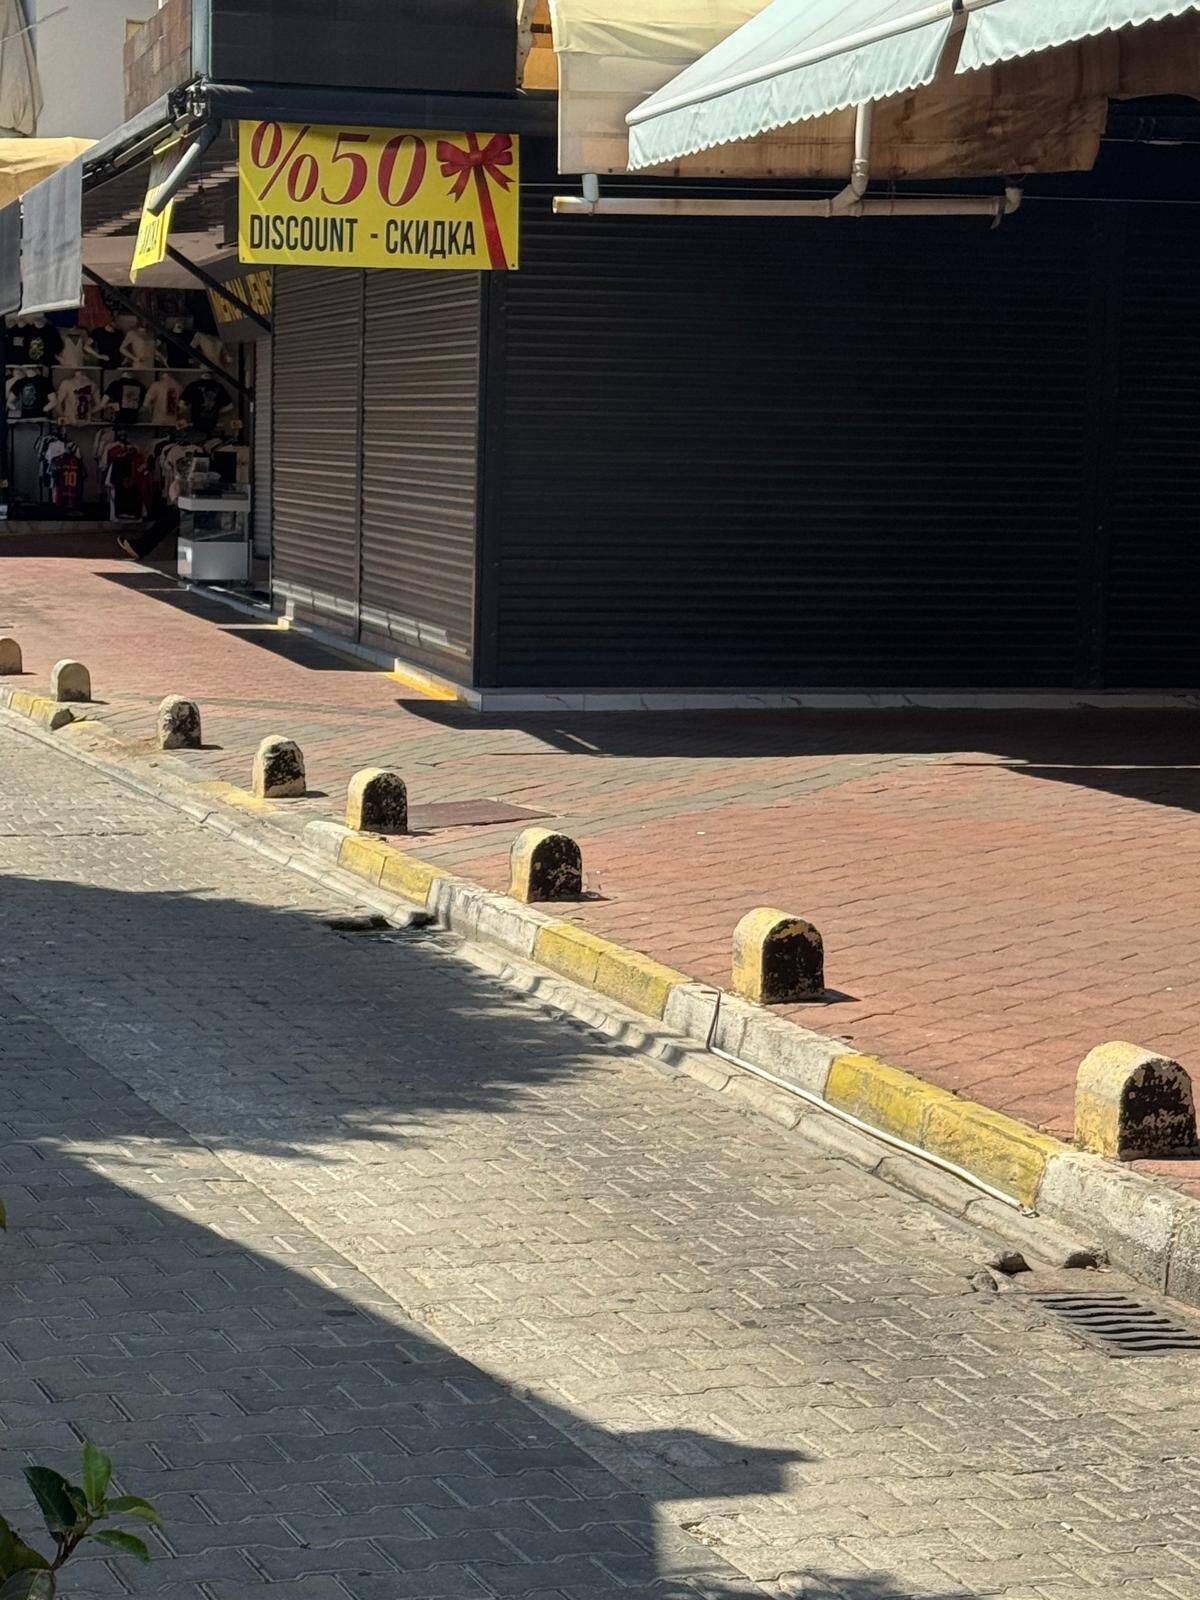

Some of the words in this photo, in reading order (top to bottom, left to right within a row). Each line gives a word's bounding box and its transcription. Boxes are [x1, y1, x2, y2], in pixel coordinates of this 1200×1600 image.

[250, 120, 427, 207] %50
[250, 214, 358, 252] DISCOUNT
[385, 219, 476, 259] СКИДКА
[64, 471, 77, 487] 10
